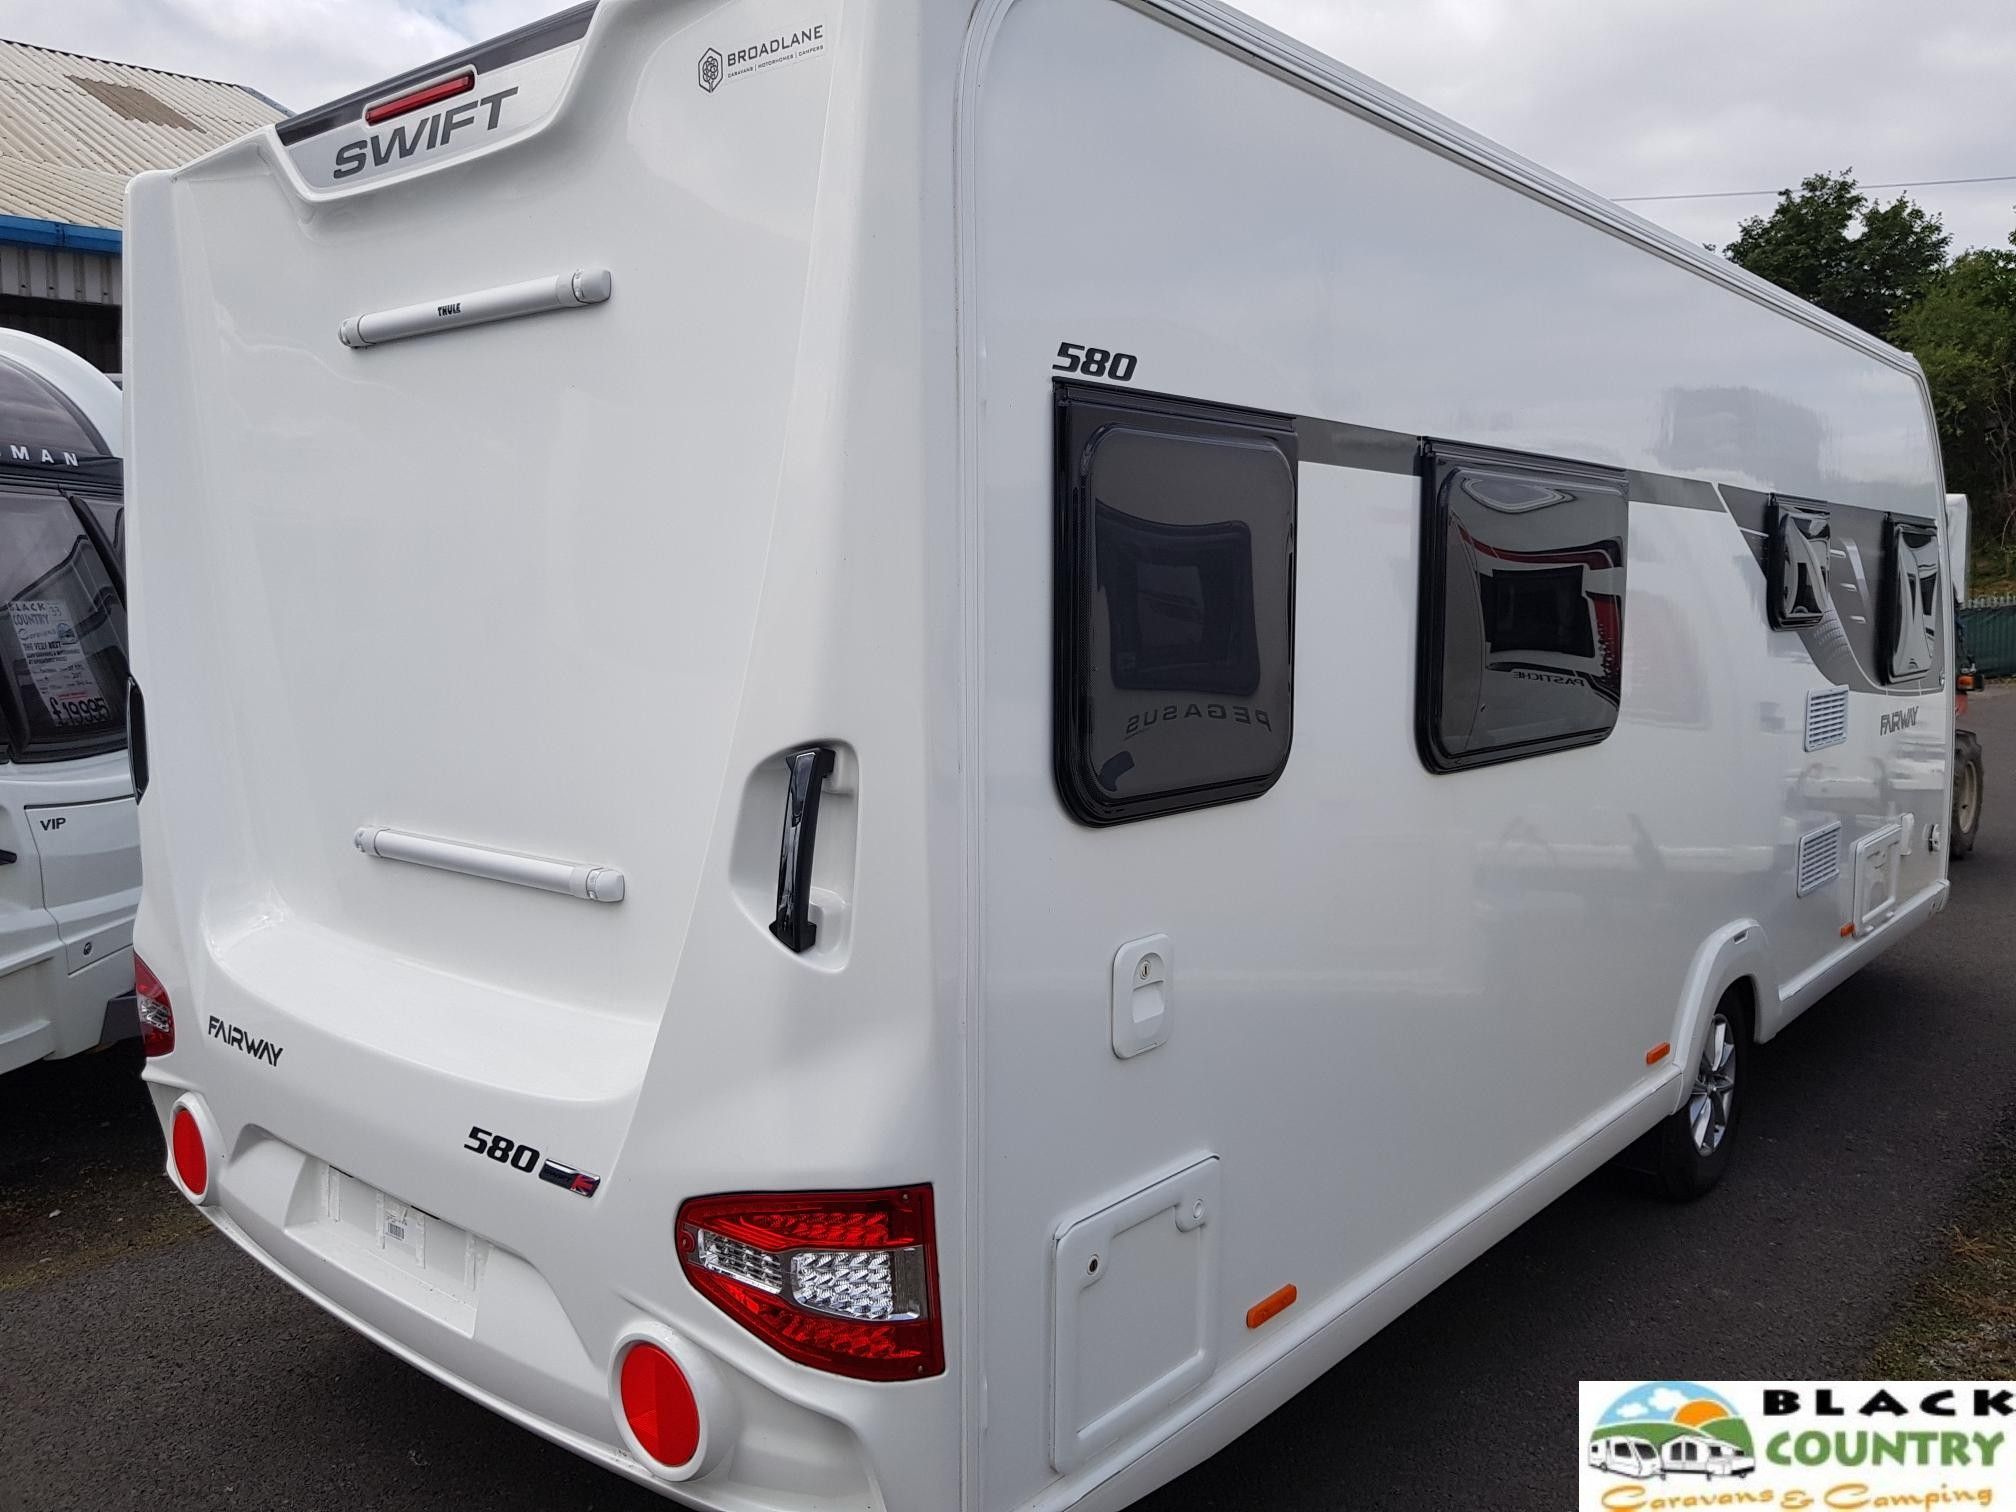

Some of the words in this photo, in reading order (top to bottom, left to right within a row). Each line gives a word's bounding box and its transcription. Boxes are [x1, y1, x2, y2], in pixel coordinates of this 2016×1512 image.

[727, 24, 824, 67] BROADLANE
[333, 86, 519, 180] SWIFT
[437, 302, 462, 317] THULE
[1052, 341, 1138, 382] 580
[0, 444, 79, 467] MAN
[1880, 705, 1919, 736] FAIRWAY
[40, 817, 66, 831] VIP
[208, 1015, 283, 1067] FAIRWAY
[463, 1126, 540, 1173] 580
